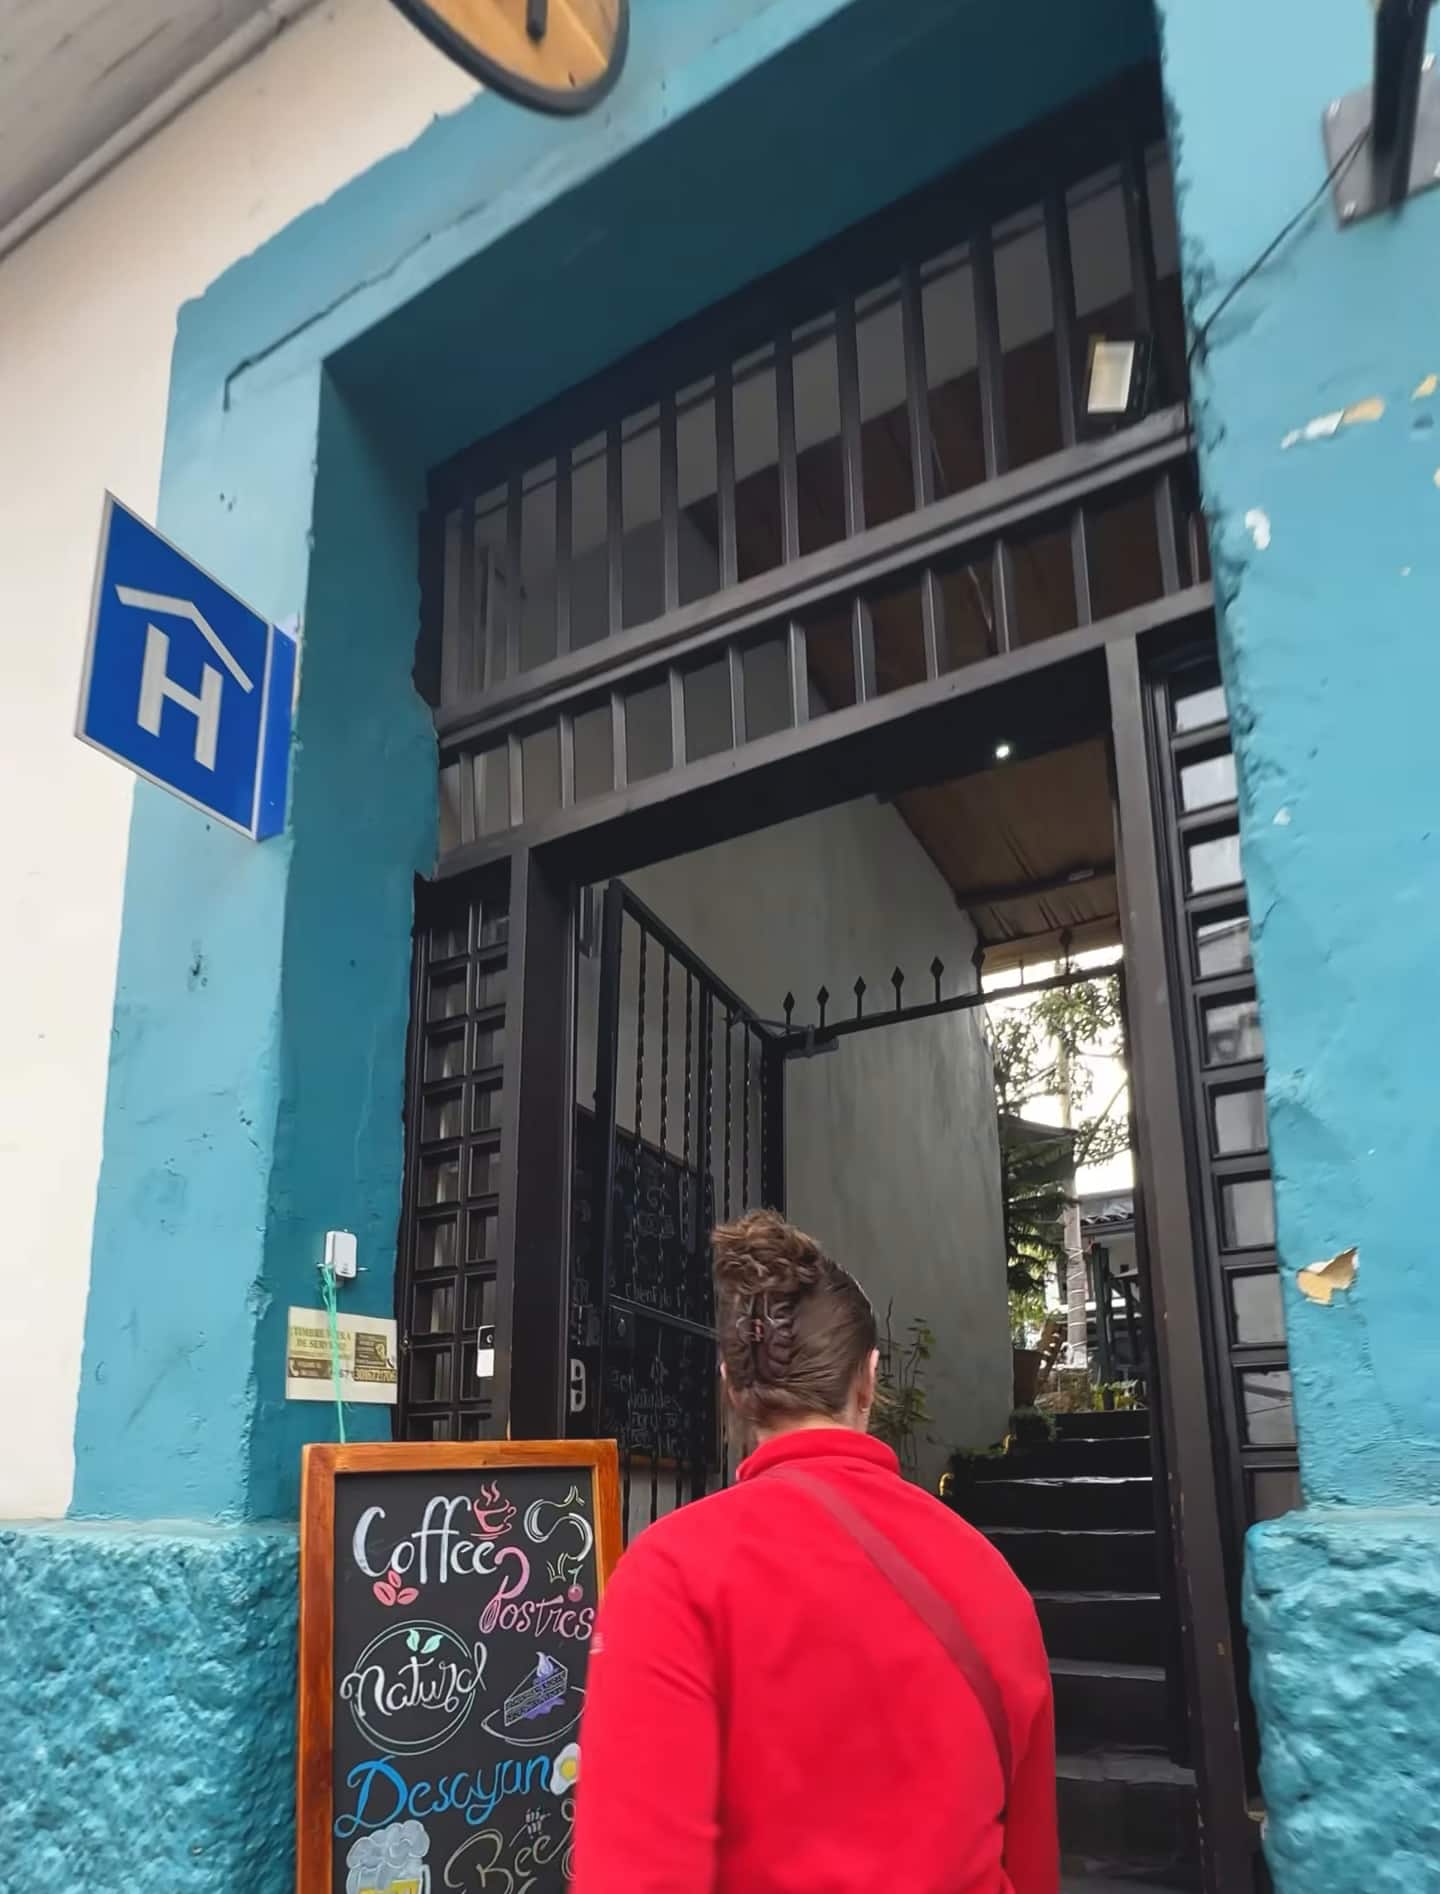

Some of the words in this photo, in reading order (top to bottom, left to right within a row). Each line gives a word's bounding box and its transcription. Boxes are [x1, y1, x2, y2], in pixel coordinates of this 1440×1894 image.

[136, 622, 223, 772] H
[352, 1496, 498, 1584] Coffee
[478, 1546, 594, 1642] Postres
